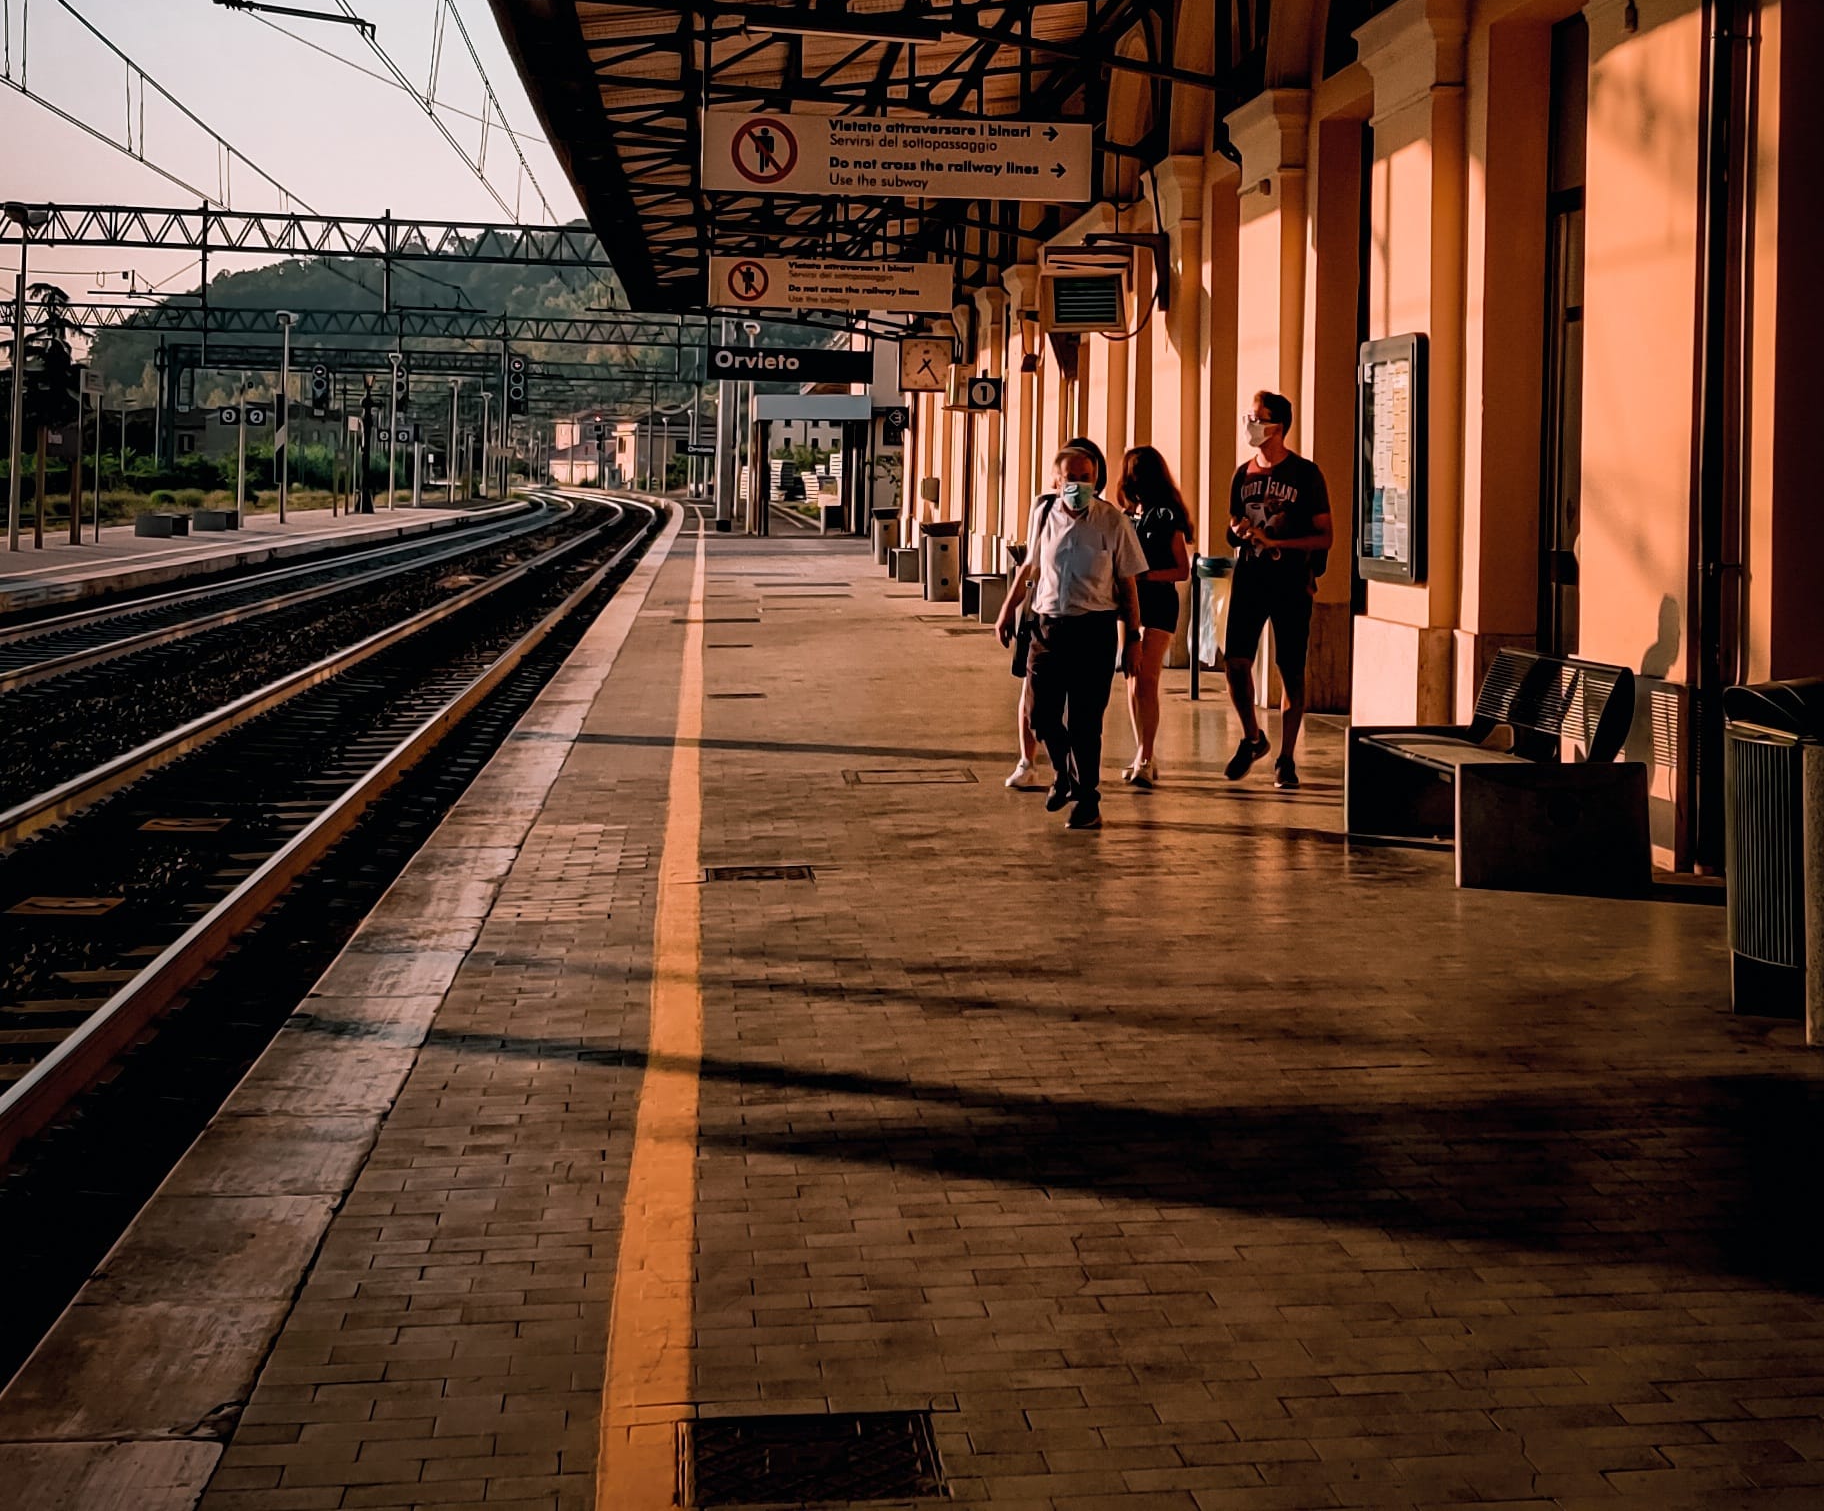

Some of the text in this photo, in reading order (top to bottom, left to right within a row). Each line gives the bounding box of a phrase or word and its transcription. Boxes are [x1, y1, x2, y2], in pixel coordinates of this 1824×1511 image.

[829, 119, 882, 133] Vietato
[886, 123, 976, 135] attraversare
[988, 125, 1030, 137] binari
[830, 134, 998, 153] Servirsi del sottopassaggio
[830, 157, 1040, 176] Do not cross the railway lines
[830, 173, 928, 191] Use the subway
[803, 285, 818, 293] not
[845, 285, 860, 294] the
[862, 287, 896, 297] railway
[714, 350, 800, 370] Orvieto
[980, 385, 988, 401] 1
[1266, 476, 1298, 503] ISLAND
